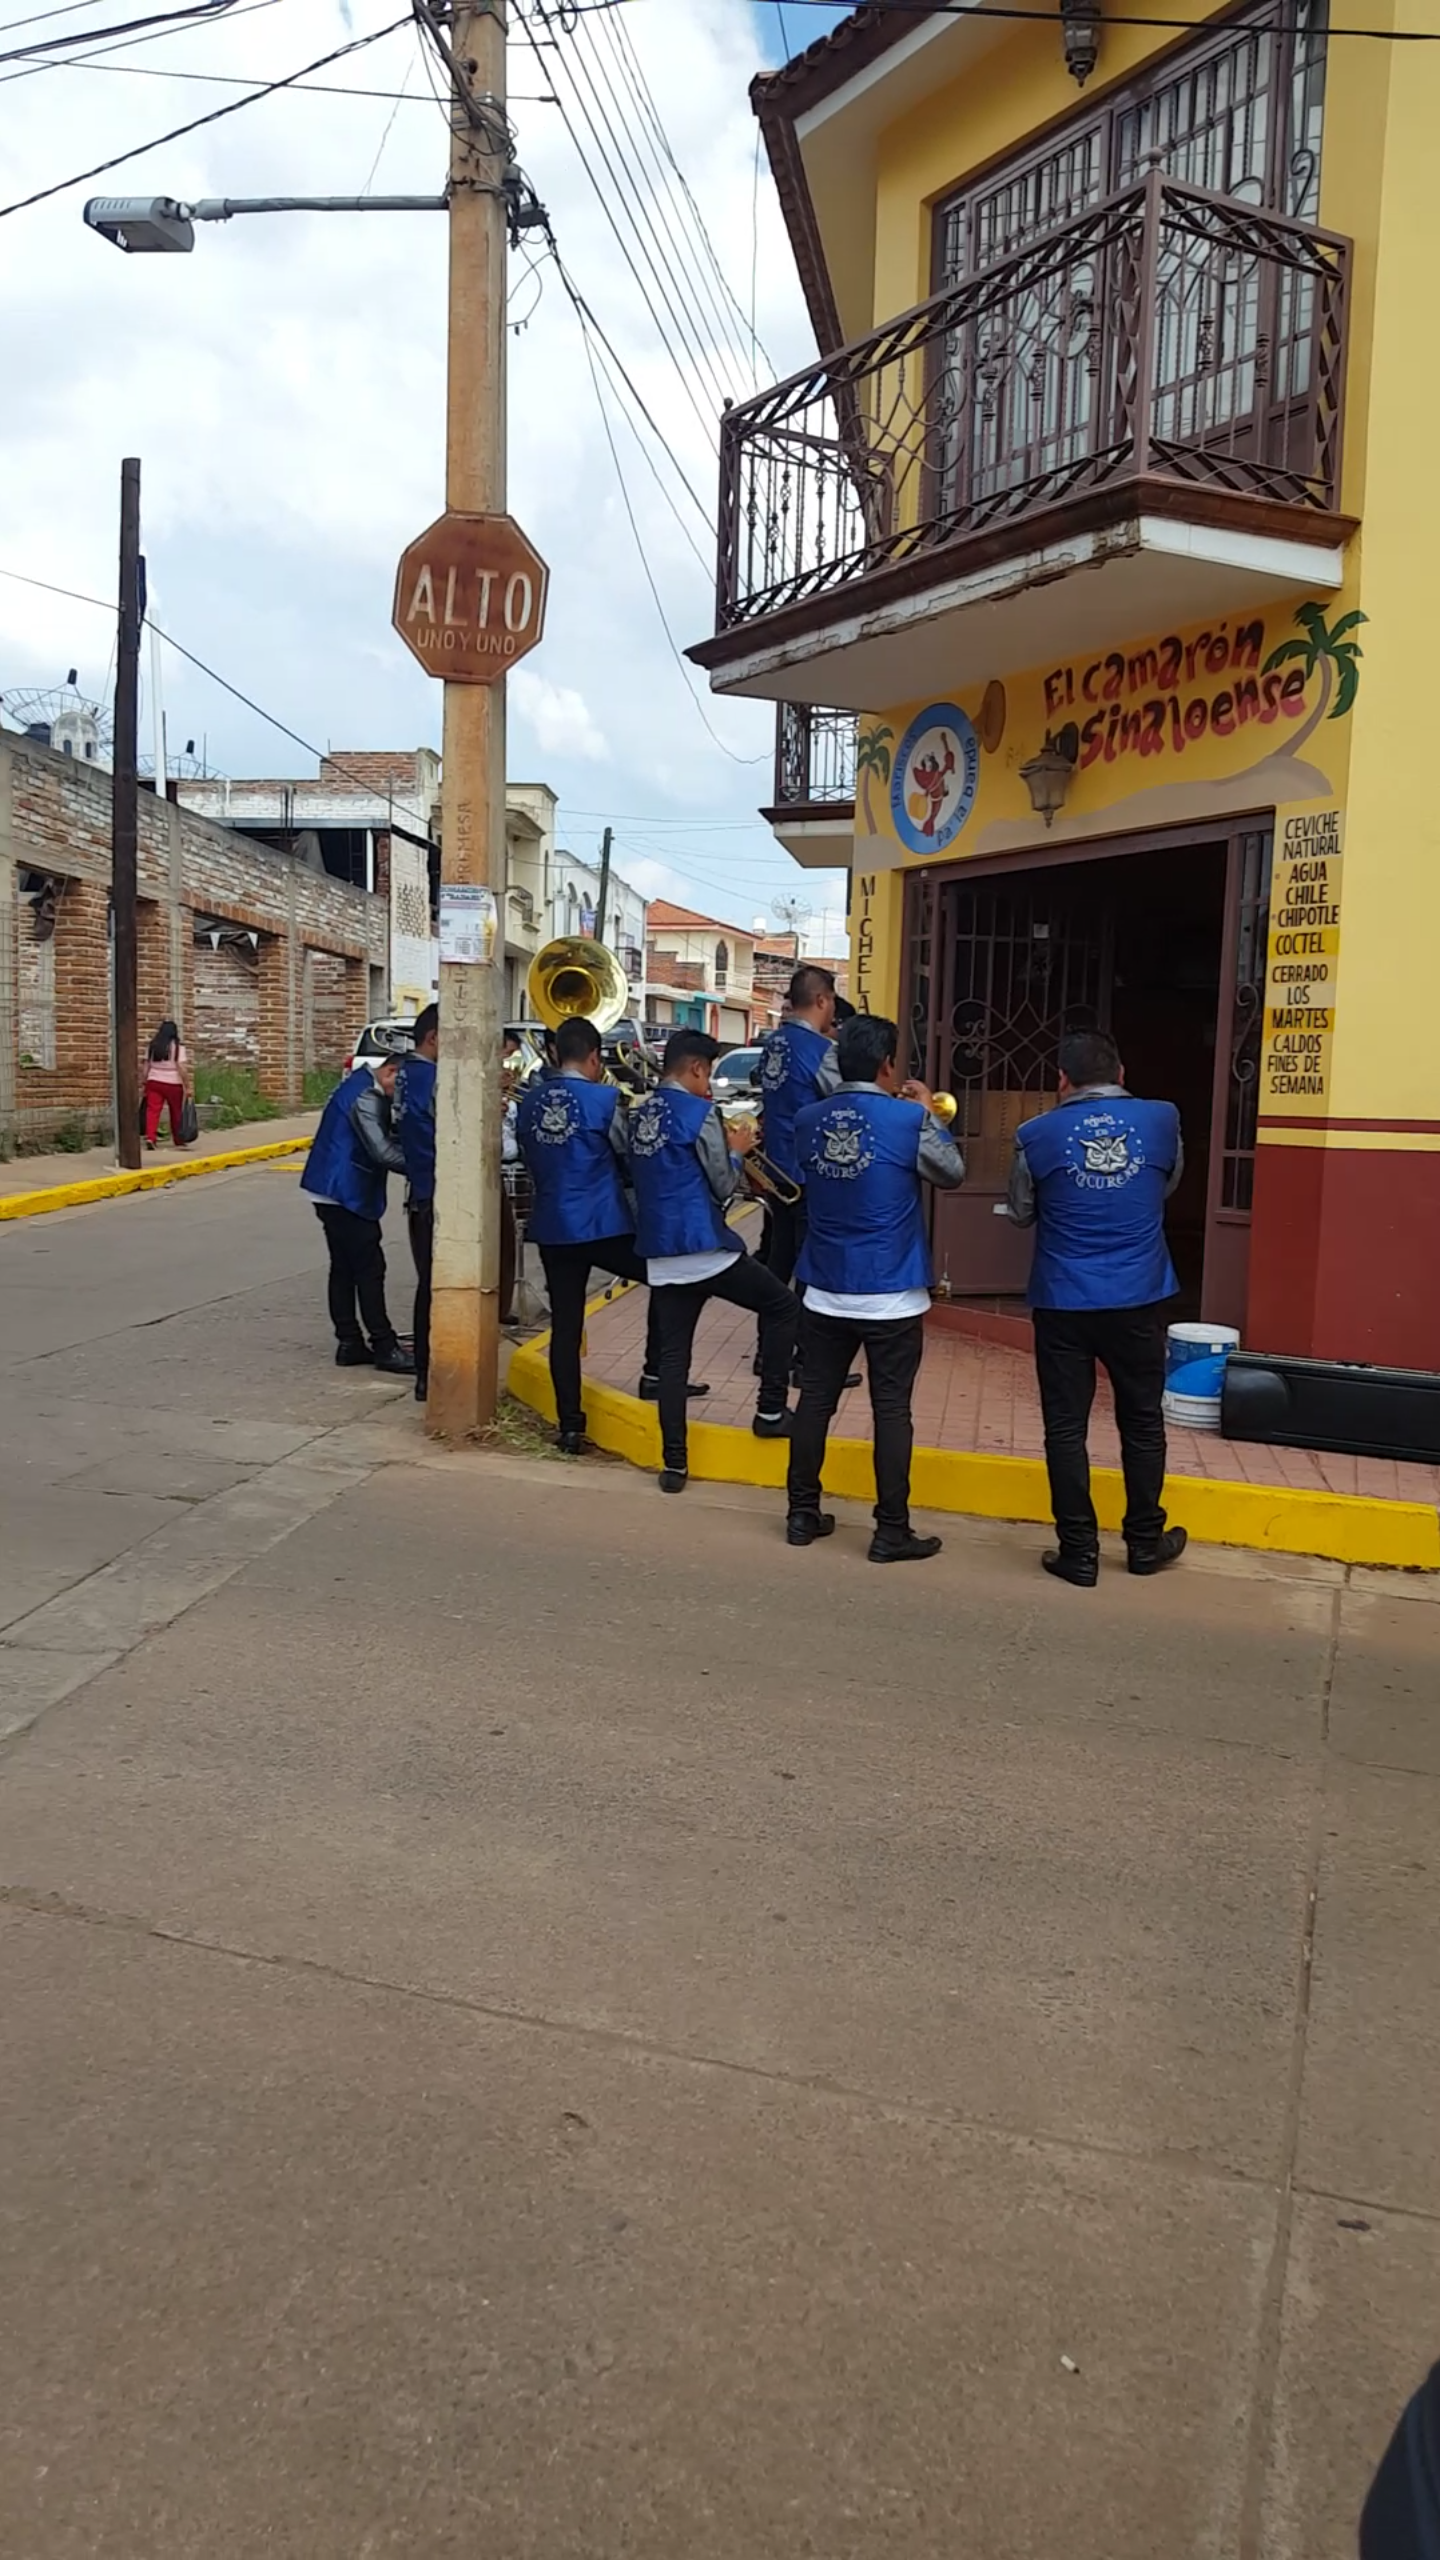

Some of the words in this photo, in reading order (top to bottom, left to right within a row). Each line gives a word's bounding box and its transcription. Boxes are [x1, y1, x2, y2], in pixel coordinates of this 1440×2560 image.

[406, 564, 533, 633] ALTO
[418, 629, 455, 650] UNO
[460, 632, 471, 651] Y
[476, 635, 516, 656] UNO
[1043, 667, 1076, 719] El
[963, 737, 977, 798] banda
[1285, 811, 1340, 840] CEVICHE
[1283, 834, 1342, 861] NATURAL
[1289, 861, 1328, 884] AGUA
[1286, 884, 1329, 906] CHILE
[1277, 905, 1340, 928] CHIPOTLE
[1275, 932, 1326, 957] COCTEL
[1272, 964, 1329, 983] CERRADO
[1287, 985, 1311, 1006] LOS
[1271, 1008, 1329, 1029] MARTES
[1273, 1034, 1323, 1053] CALDOS
[1267, 1055, 1298, 1073] FINES
[1303, 1055, 1322, 1073] DE
[1269, 1075, 1325, 1095] SEMANA
